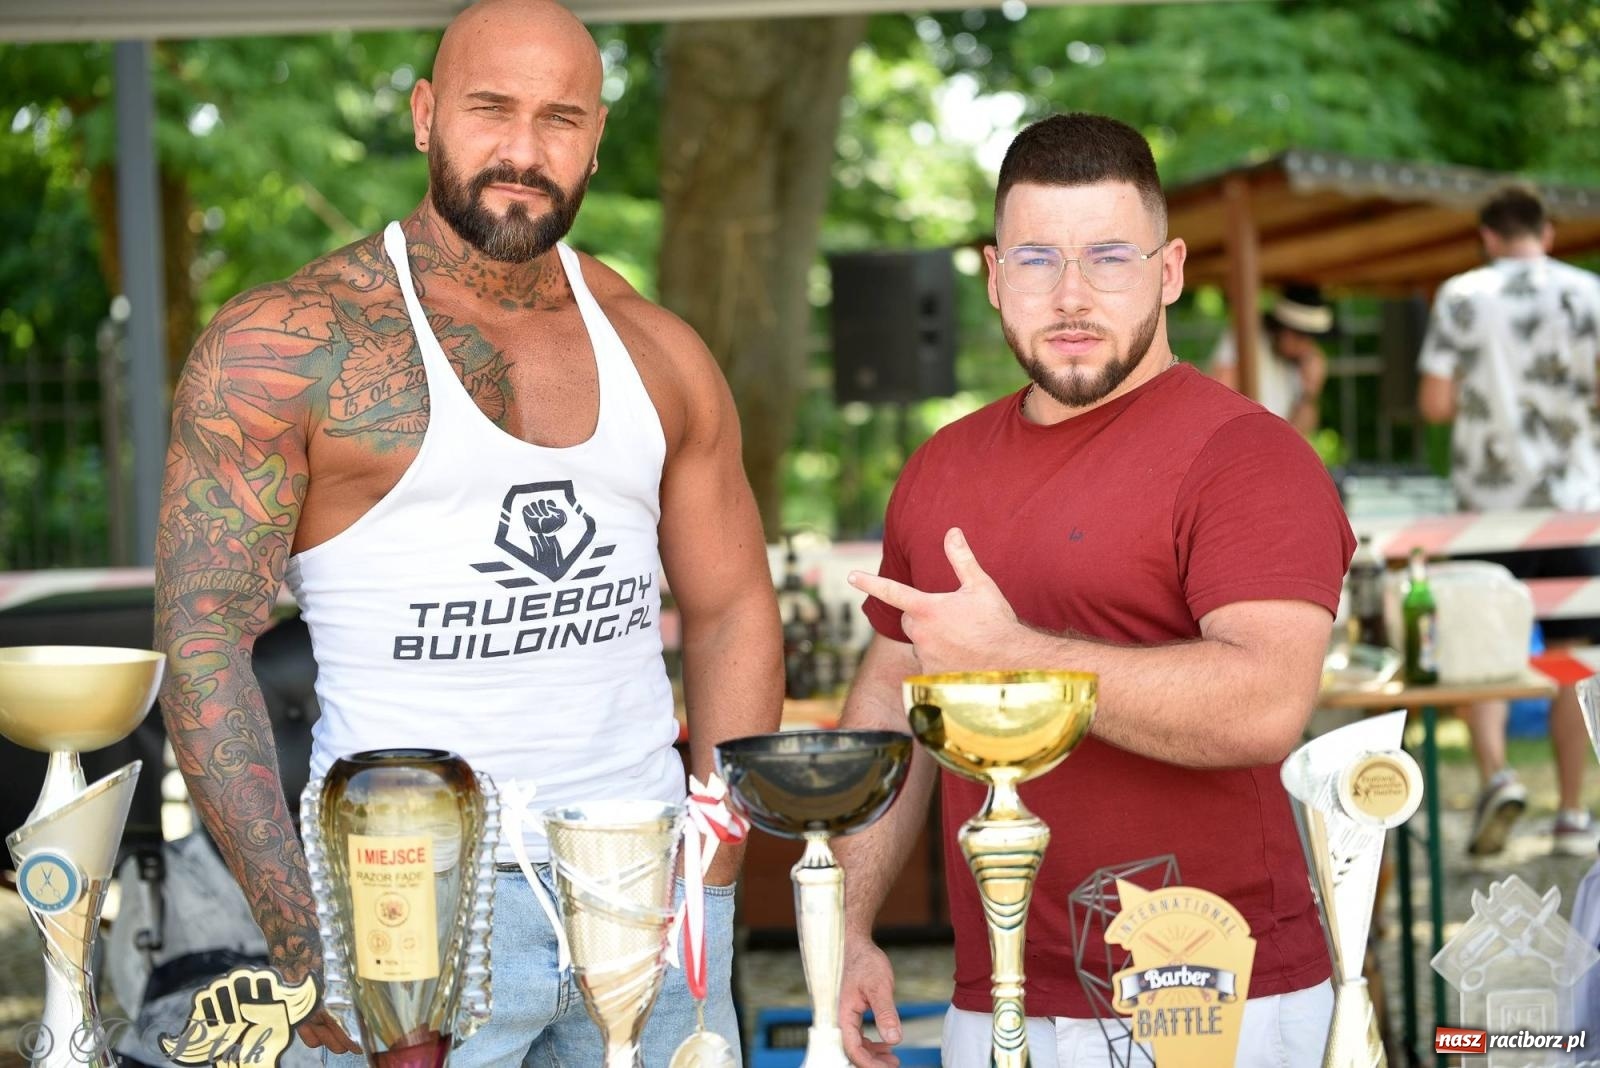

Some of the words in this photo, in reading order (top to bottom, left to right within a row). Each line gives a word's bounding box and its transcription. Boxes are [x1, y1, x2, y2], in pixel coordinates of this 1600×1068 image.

[409, 573, 652, 628] TRUEBODY
[393, 605, 652, 661] BUILDING.PL
[364, 847, 427, 866] MIEJSCE
[356, 871, 393, 883] RAZOR
[395, 871, 424, 882] FADE
[1115, 896, 1239, 941] INTERNATIONAL
[1144, 966, 1211, 989] Barber
[1137, 1005, 1223, 1038] BATTLE
